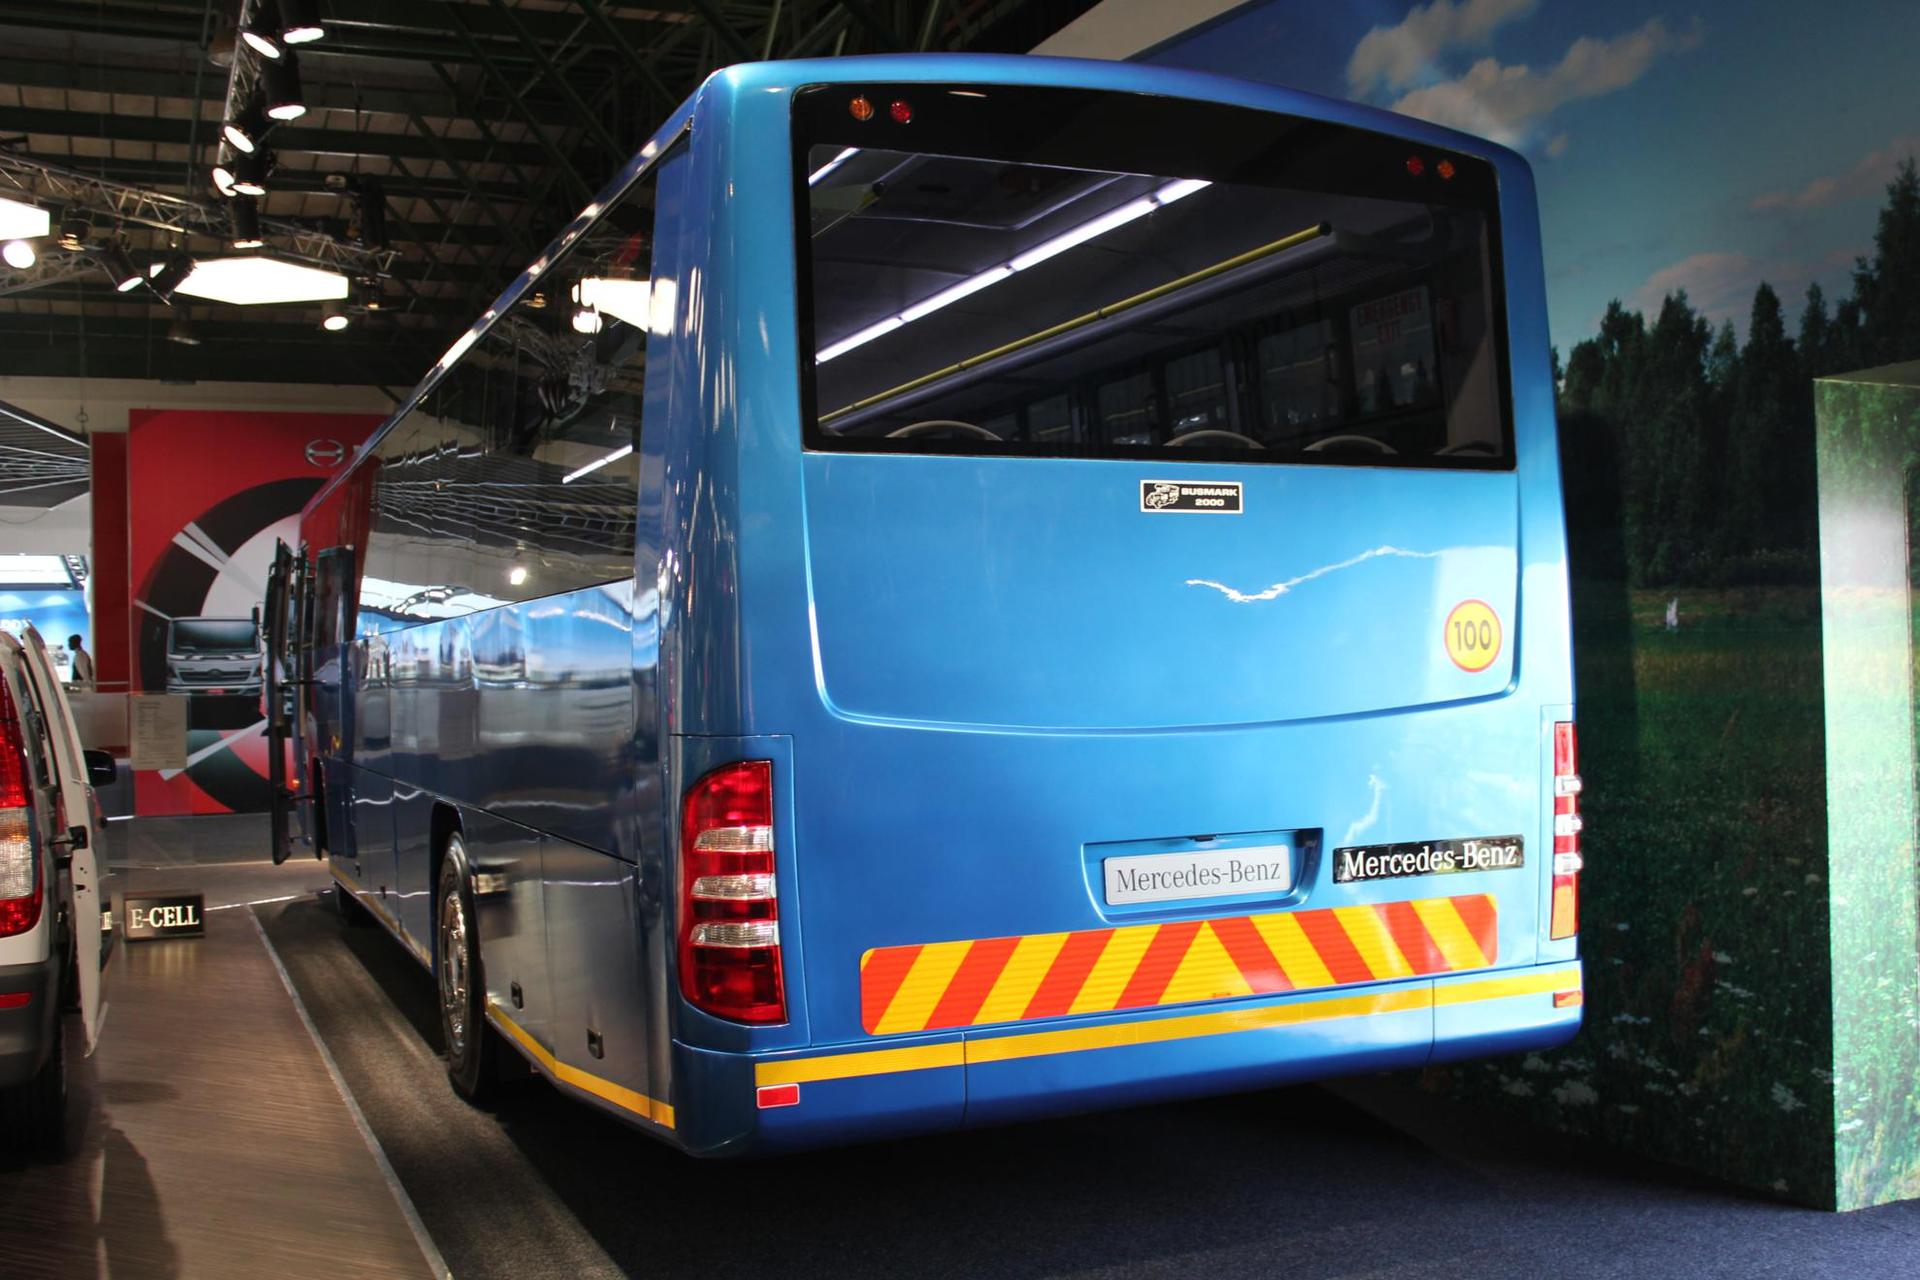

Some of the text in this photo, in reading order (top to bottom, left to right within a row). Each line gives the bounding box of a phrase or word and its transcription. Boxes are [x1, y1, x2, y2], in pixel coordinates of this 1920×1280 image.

[1181, 487, 1238, 497] BUSMARK
[1195, 498, 1225, 507] 2000
[1454, 619, 1492, 652] 100
[1343, 841, 1518, 879] Mercedes-Benz
[1116, 859, 1281, 893] Mercedes-Benz
[130, 905, 200, 929] E-CELL
